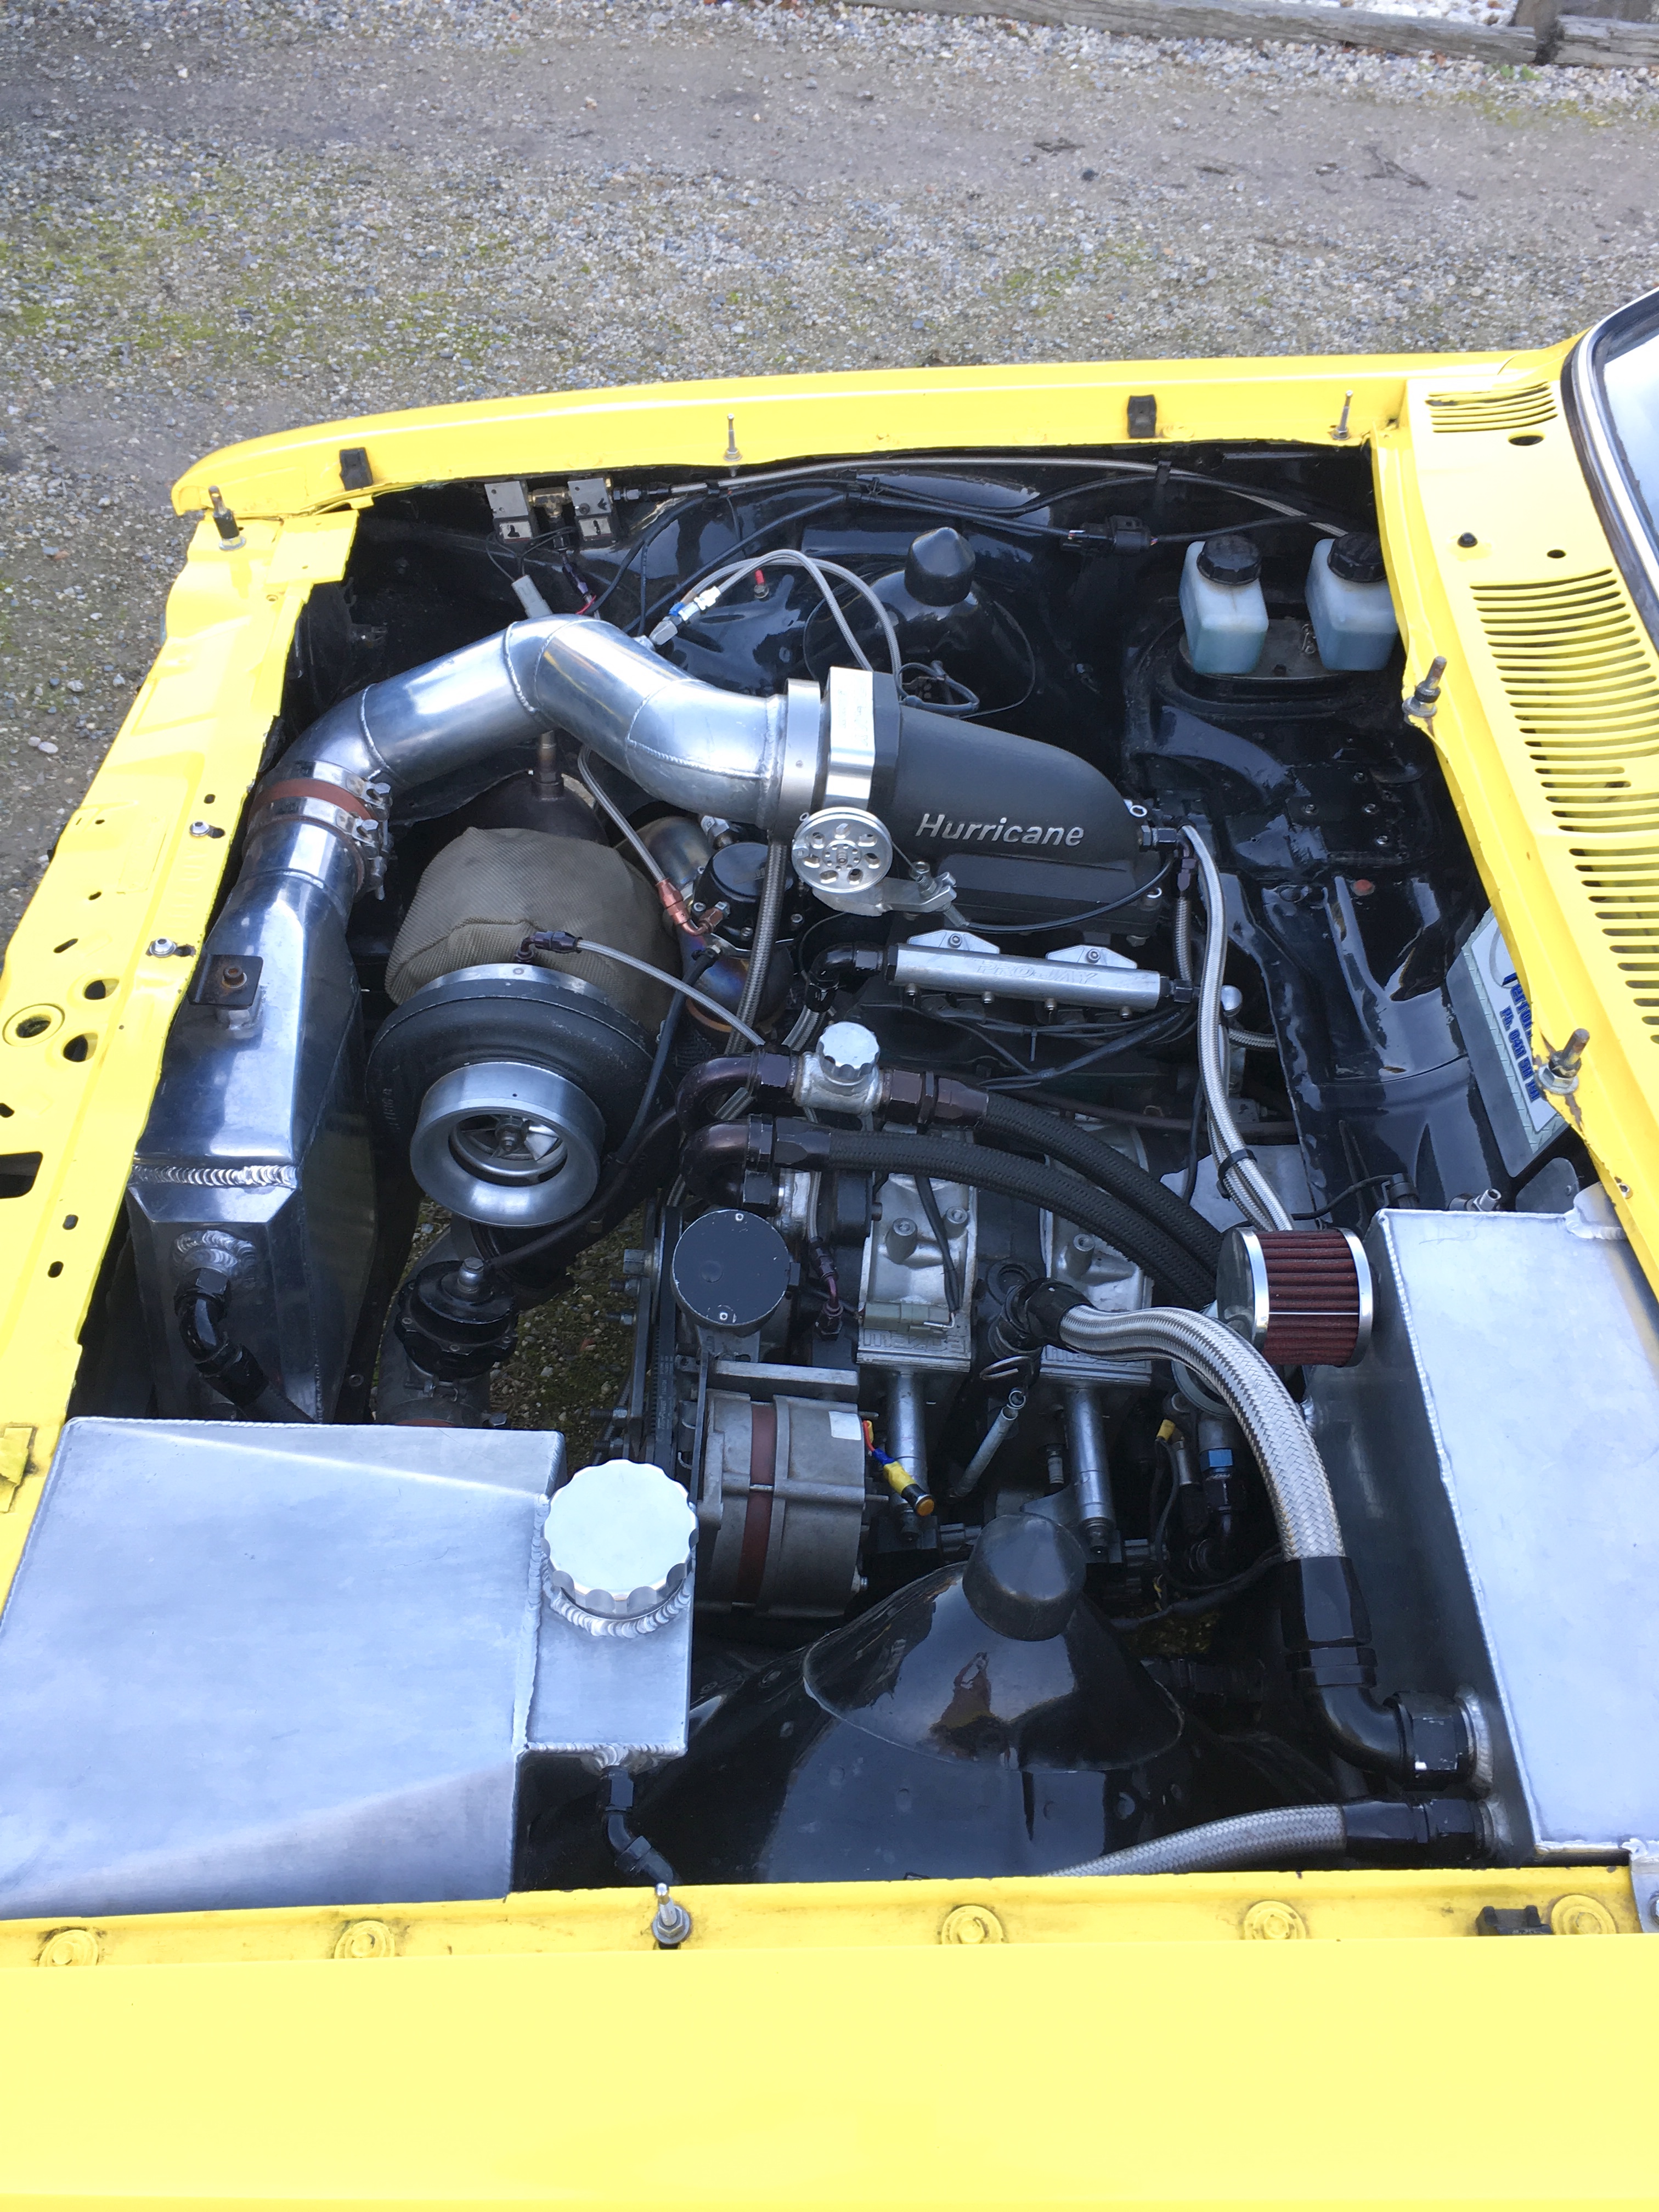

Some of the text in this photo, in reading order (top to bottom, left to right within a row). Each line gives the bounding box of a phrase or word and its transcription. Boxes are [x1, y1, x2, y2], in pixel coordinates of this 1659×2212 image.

[915, 813, 1084, 847] Hurricane
[1499, 1005, 1514, 1031] Ph.
[1508, 1028, 1527, 1061] 0411
[1517, 1056, 1535, 1081] 511
